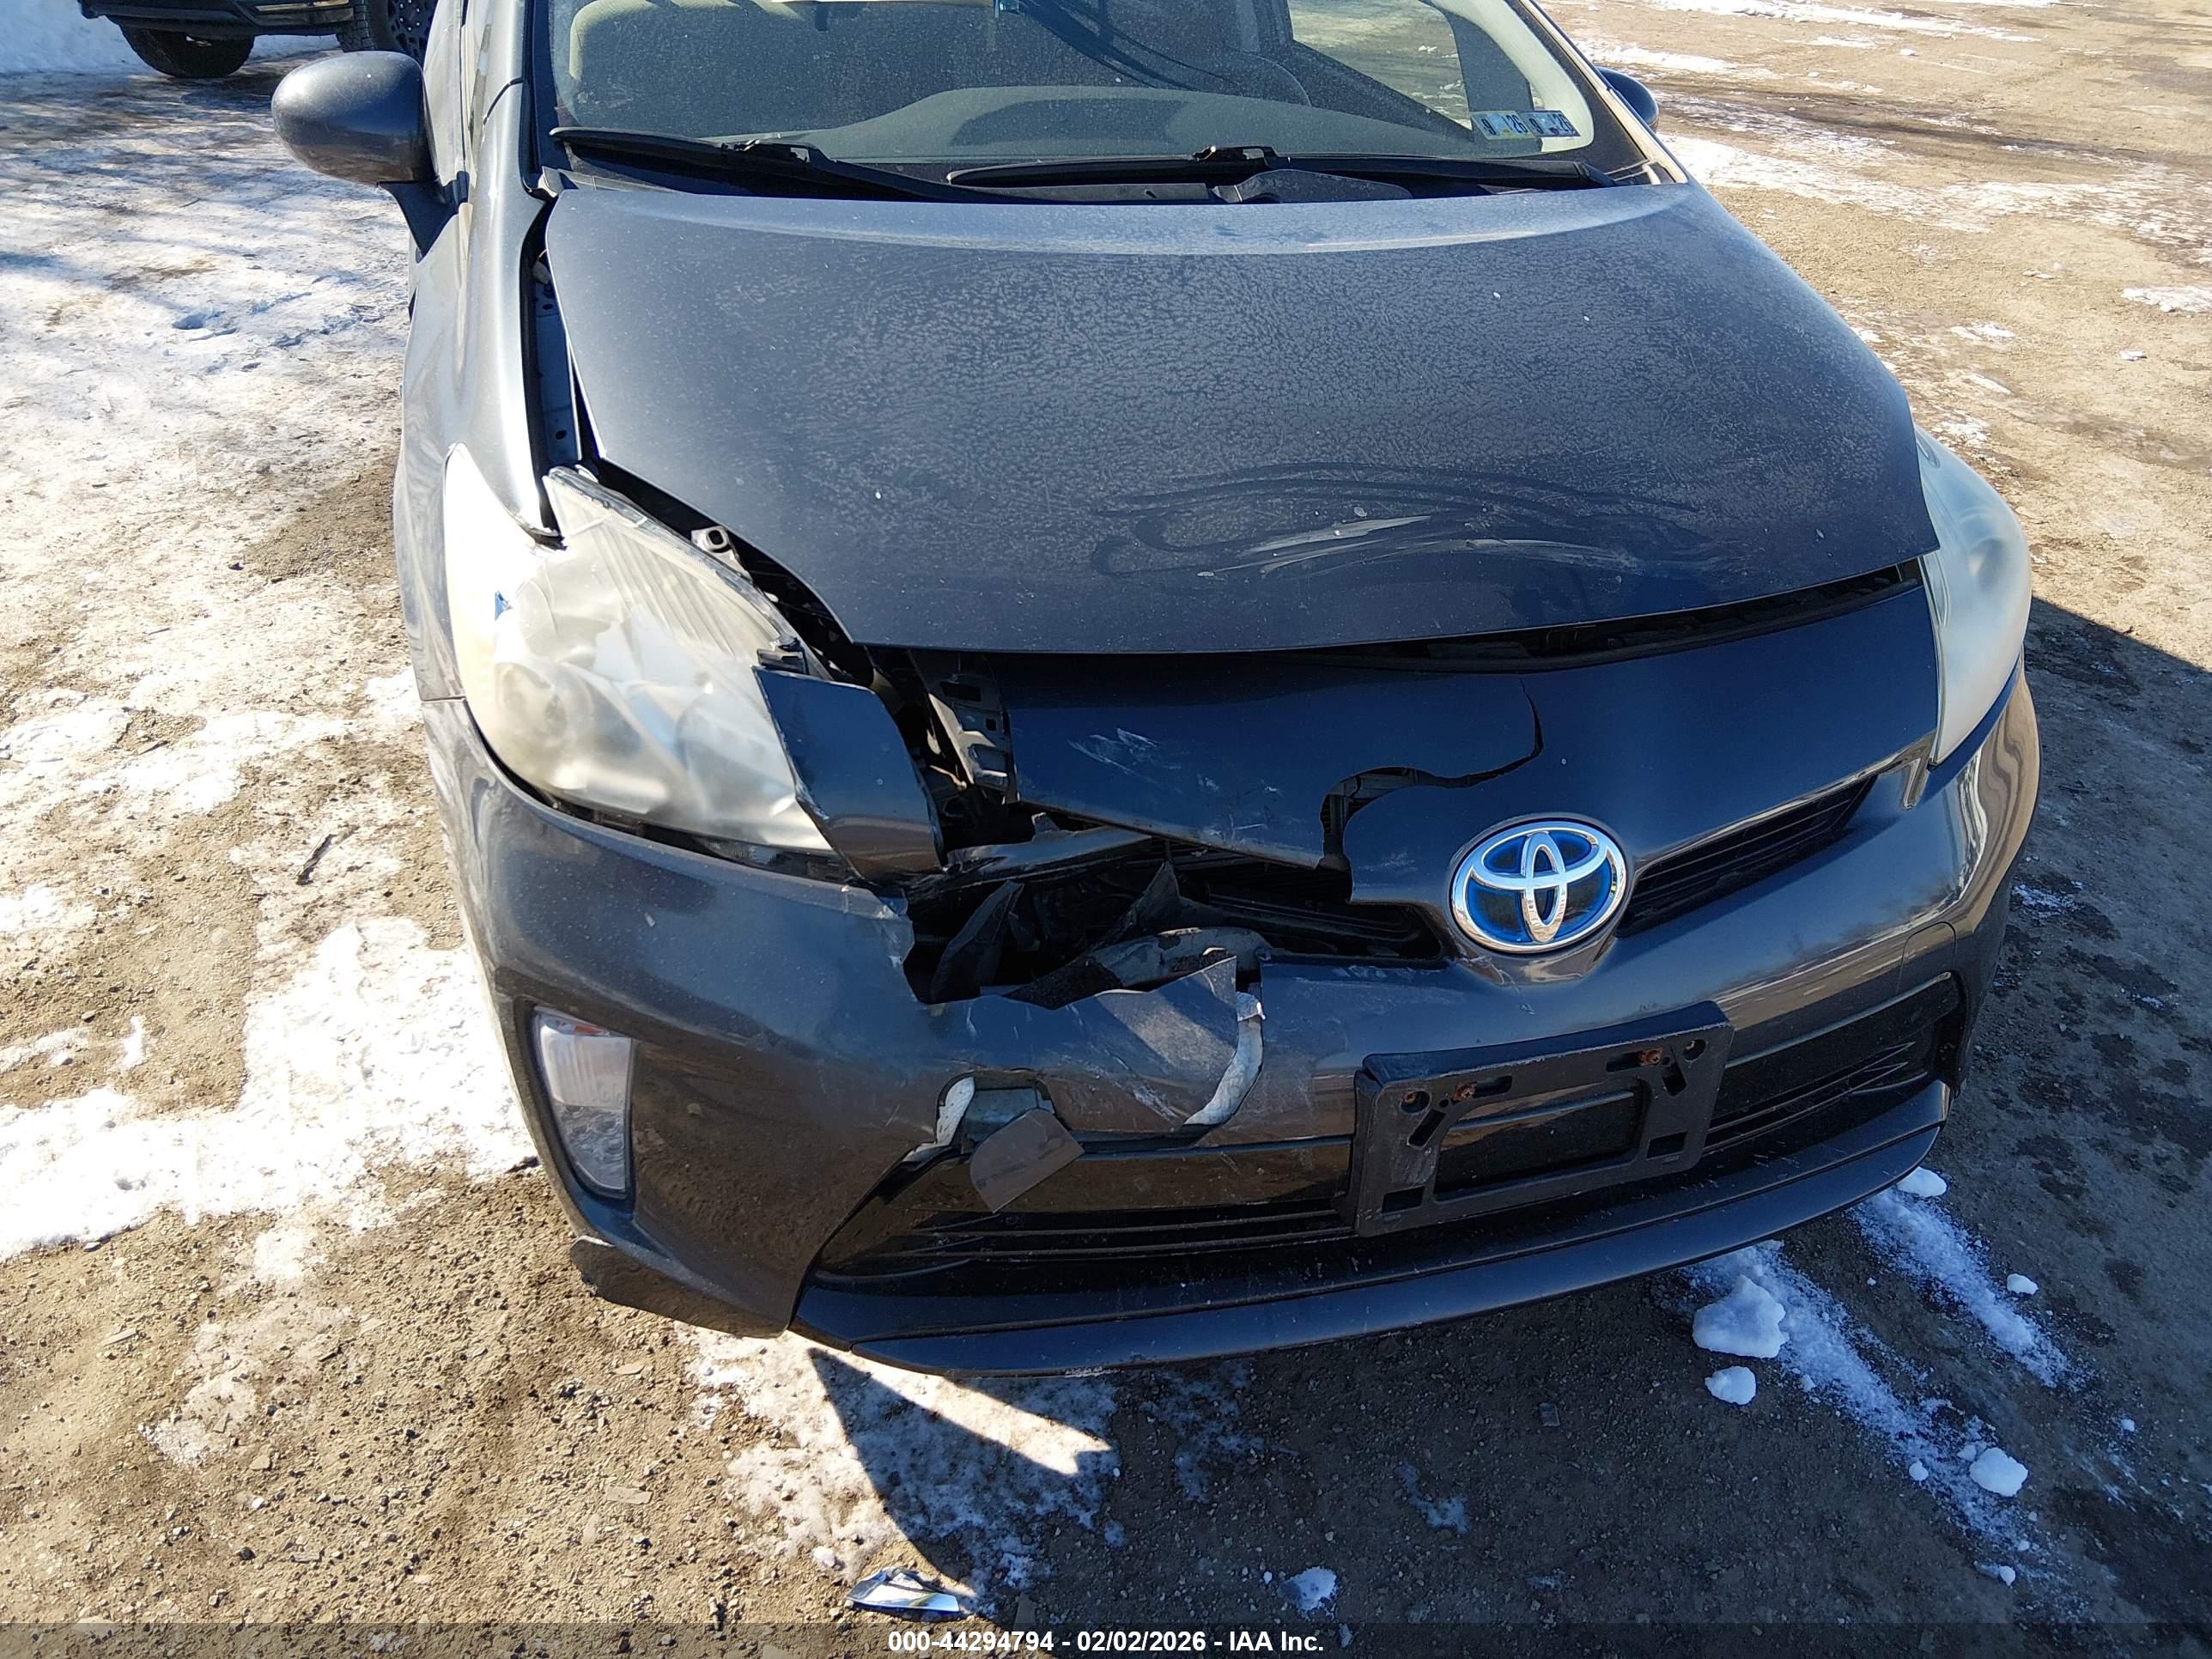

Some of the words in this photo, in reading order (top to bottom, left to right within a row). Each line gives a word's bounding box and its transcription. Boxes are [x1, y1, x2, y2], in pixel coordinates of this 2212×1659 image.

[1481, 118, 1497, 136] 9
[1506, 114, 1528, 134] 26
[1529, 118, 1544, 134] 9
